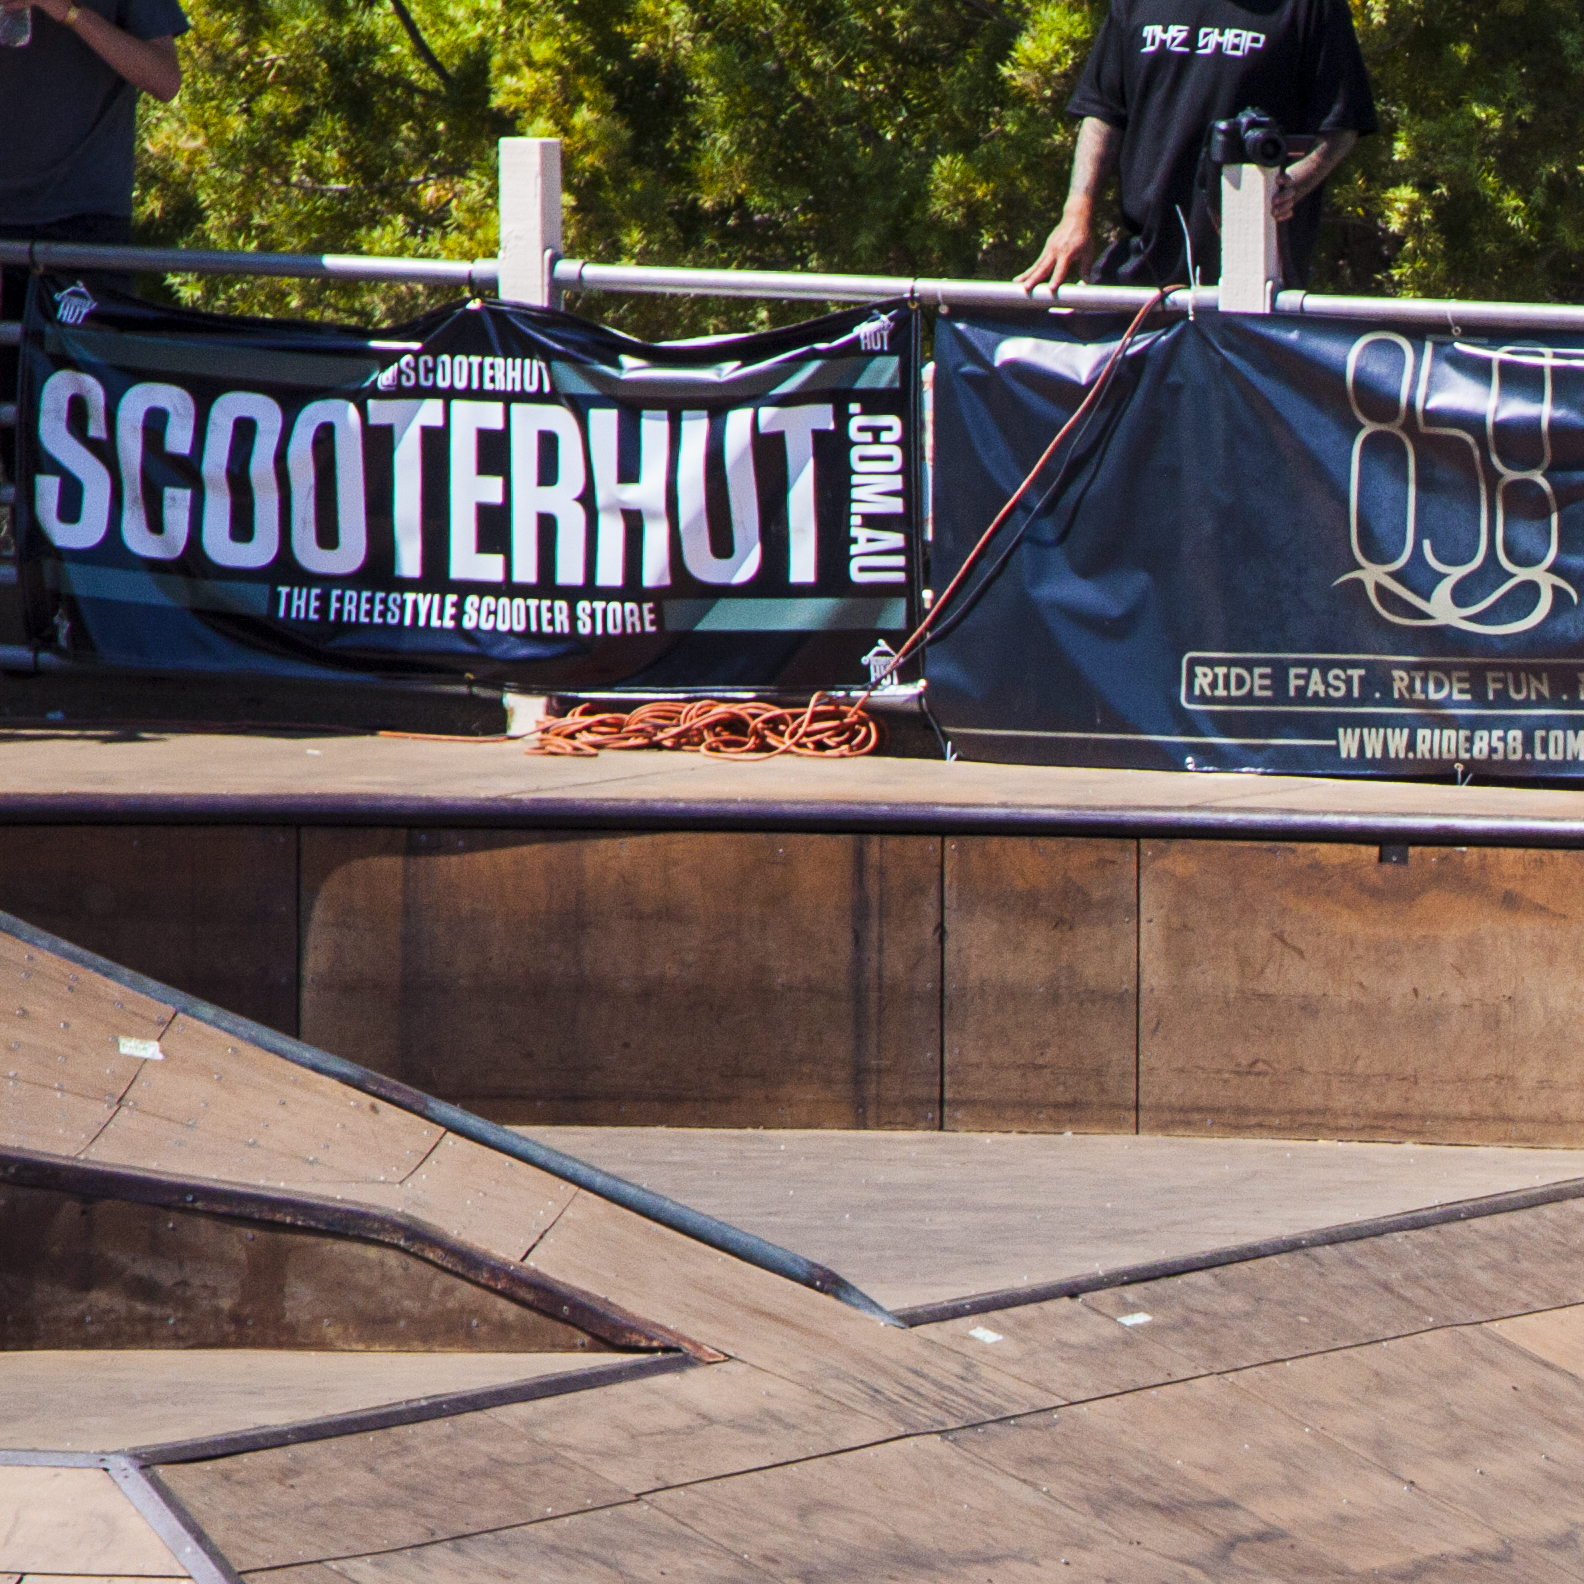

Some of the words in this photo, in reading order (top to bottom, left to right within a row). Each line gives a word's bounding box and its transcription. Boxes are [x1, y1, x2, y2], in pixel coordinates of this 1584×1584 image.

[377, 354, 551, 394] @SCOOTERHUT
[35, 369, 835, 587] SCOOTERHUT
[277, 587, 321, 621] THE
[329, 589, 459, 628] FREESTYLE
[463, 595, 570, 634] SCOOTER
[576, 600, 657, 635] STORE
[1193, 666, 1274, 698] RIDE
[1393, 669, 1473, 700] RIDE
